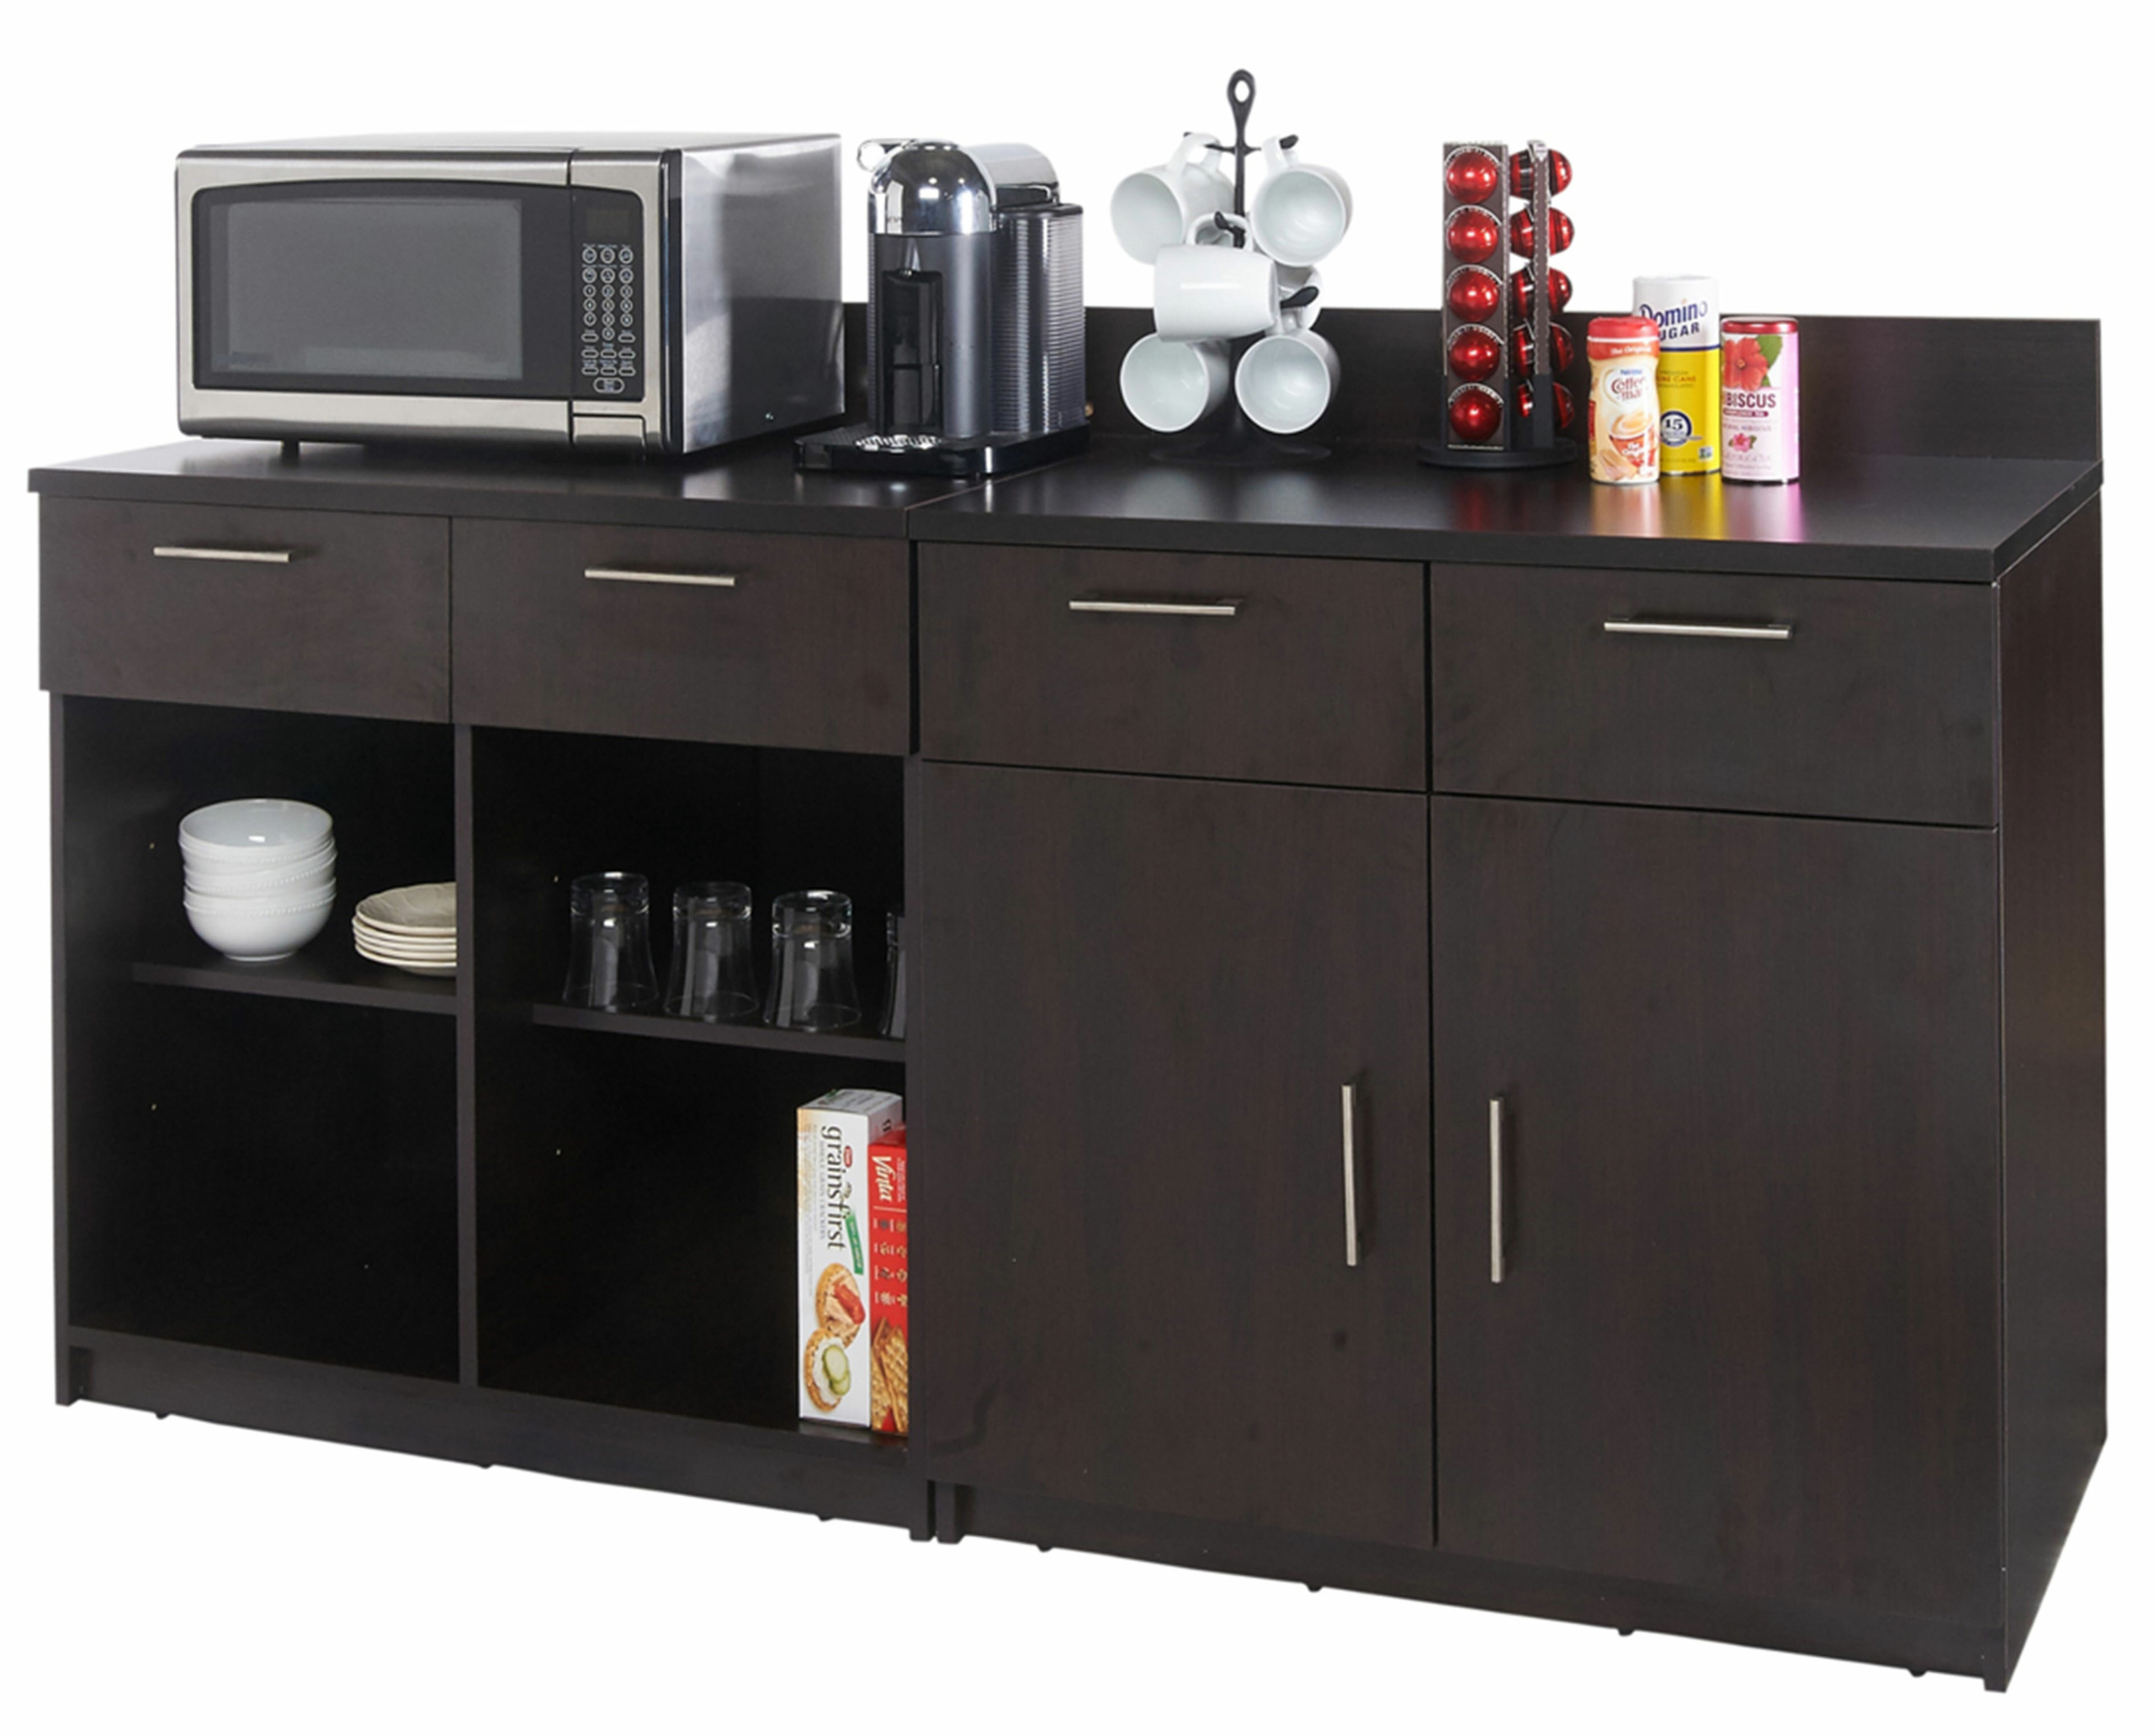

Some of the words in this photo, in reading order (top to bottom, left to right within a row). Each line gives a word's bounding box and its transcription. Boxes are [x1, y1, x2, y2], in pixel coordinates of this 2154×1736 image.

[1640, 301, 1707, 327] Domino
[1658, 322, 1700, 341] UGAR
[1665, 418, 1683, 430] 15
[821, 1126, 851, 1250] grainsfirst
[872, 1155, 896, 1202] Vinta
